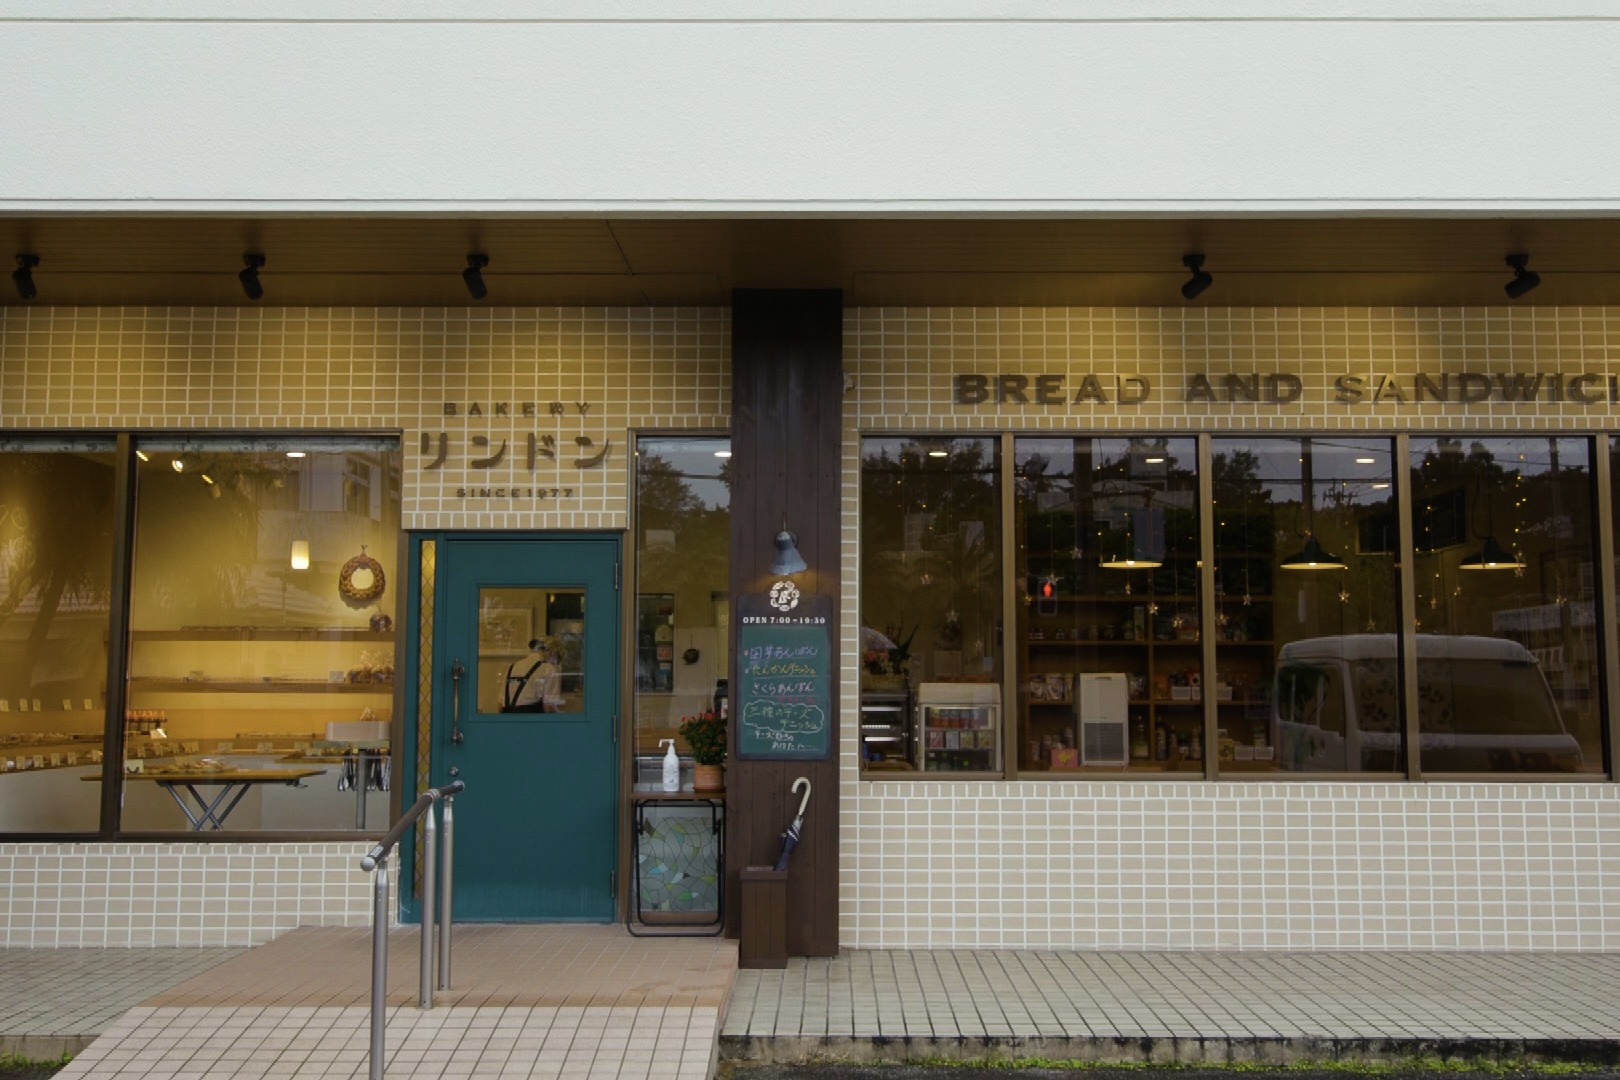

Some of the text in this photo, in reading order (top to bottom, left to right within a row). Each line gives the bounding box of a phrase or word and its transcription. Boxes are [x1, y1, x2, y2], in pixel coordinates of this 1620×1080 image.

[956, 374, 1150, 404] BREAD
[1186, 374, 1301, 404] AND
[444, 402, 590, 416] BAKERY
[421, 432, 611, 470] リンドン
[743, 616, 767, 624] OPEN
